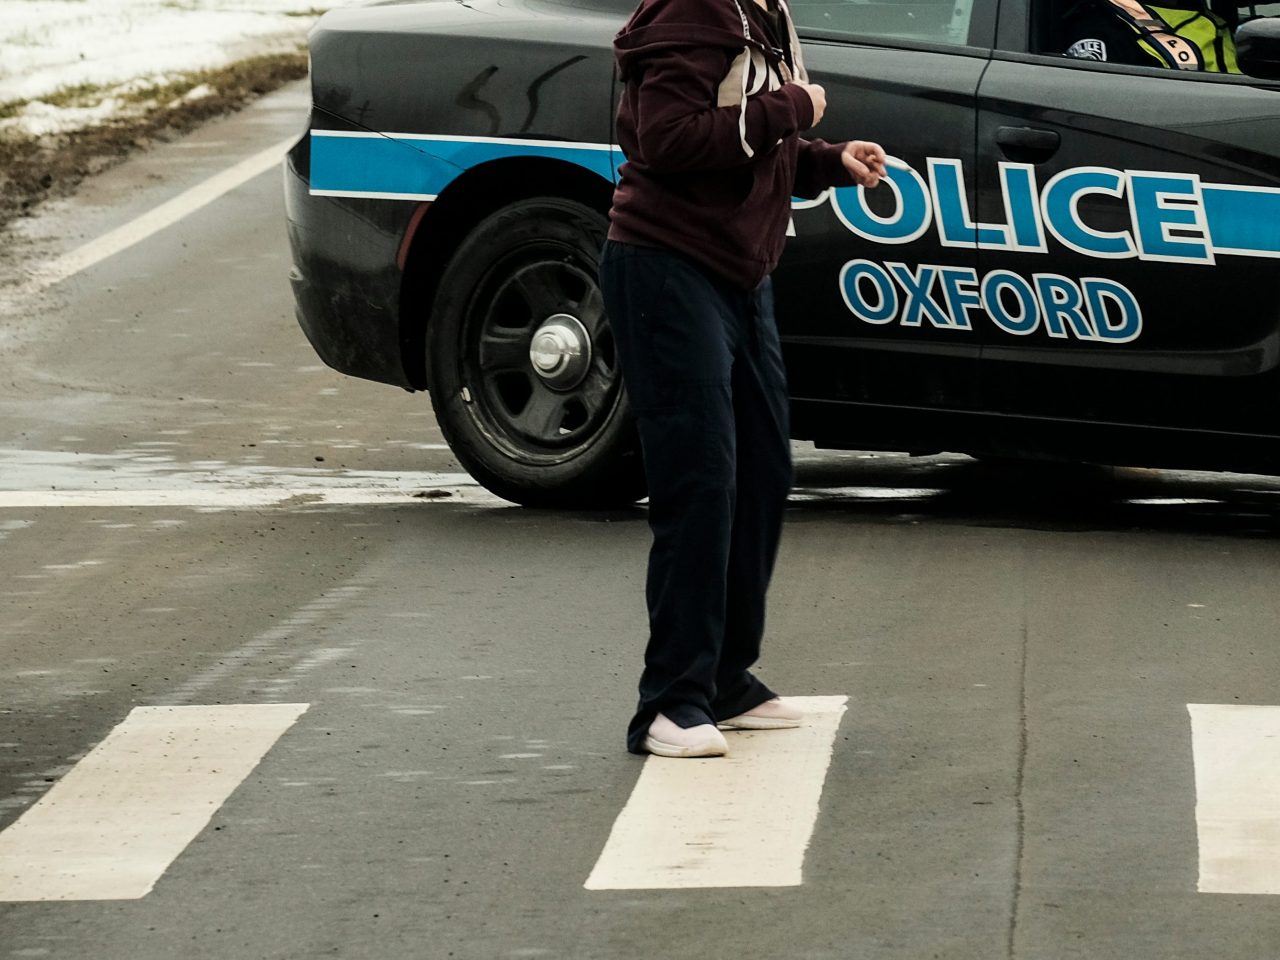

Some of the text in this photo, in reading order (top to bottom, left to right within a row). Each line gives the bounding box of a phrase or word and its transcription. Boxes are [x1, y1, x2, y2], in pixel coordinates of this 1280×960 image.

[1167, 40, 1189, 70] PO
[786, 156, 1216, 265] OLICE
[839, 258, 1143, 344] OXFORD
